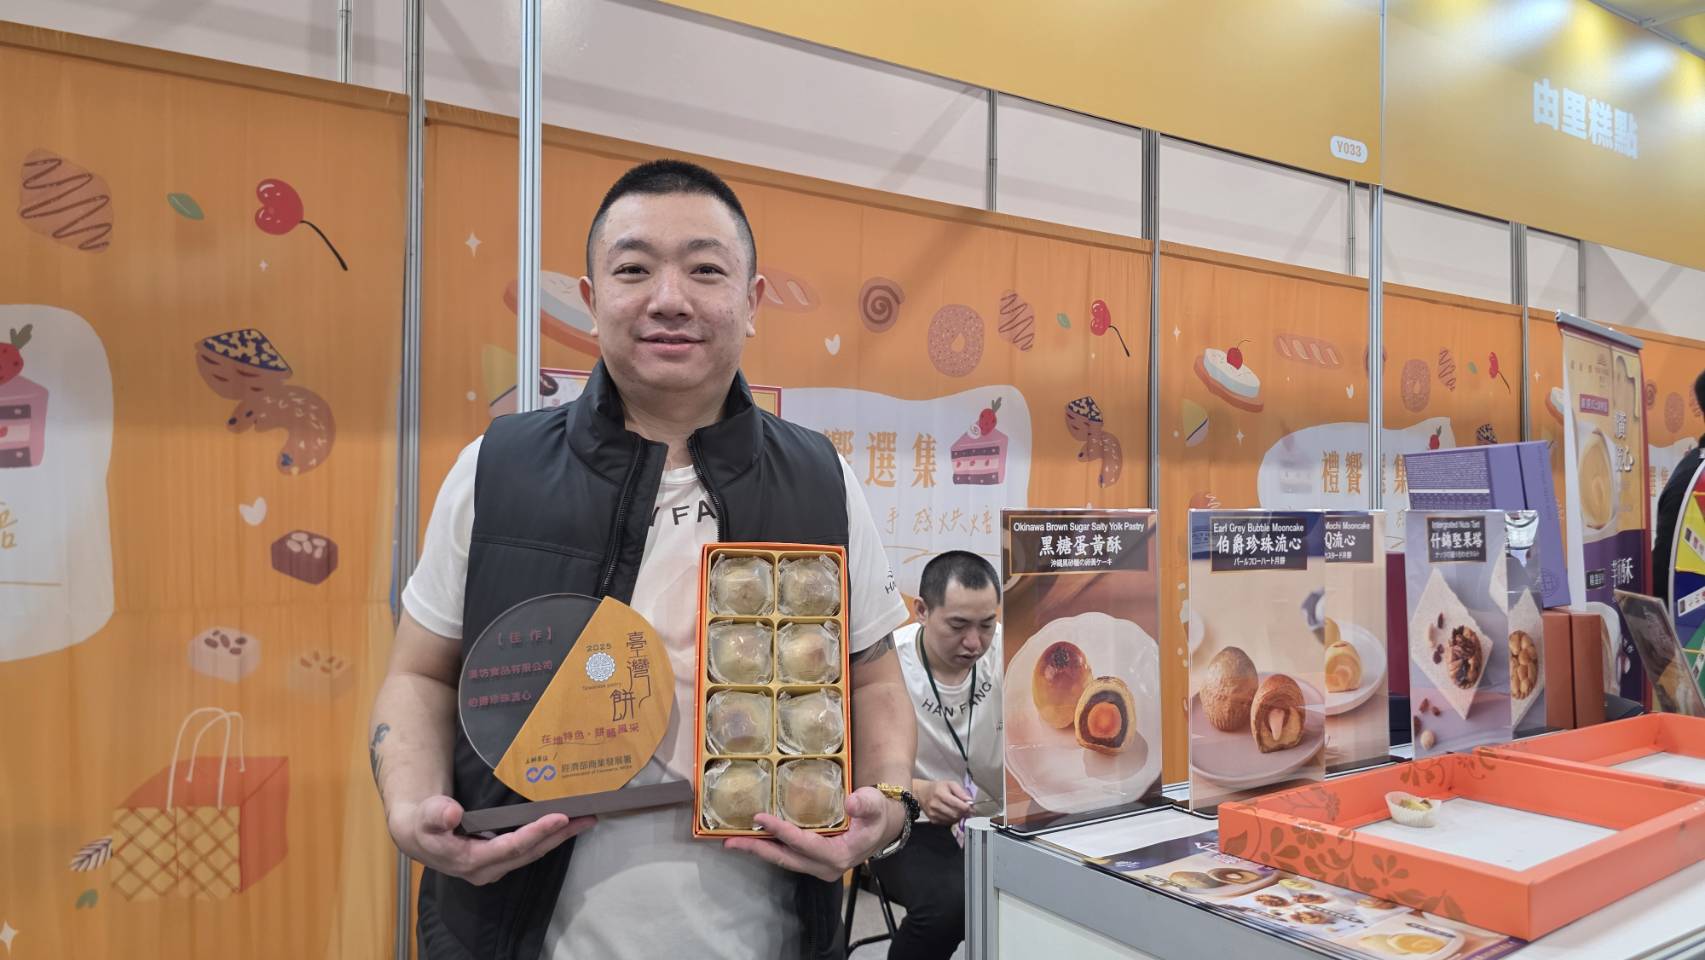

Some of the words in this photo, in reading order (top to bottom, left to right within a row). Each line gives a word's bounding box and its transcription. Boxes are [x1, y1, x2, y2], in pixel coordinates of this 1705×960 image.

[1533, 79, 1638, 159] 由里糕點
[1336, 140, 1362, 157] Y033
[672, 500, 717, 531] FA
[1013, 523, 1045, 531] Okinawa
[1046, 523, 1068, 531] Brown
[1070, 523, 1090, 533] Sugar
[1091, 522, 1108, 532] Salty
[1109, 522, 1122, 531] Yolk
[1124, 523, 1144, 532] Pastry
[1213, 522, 1228, 533] Earl
[1229, 523, 1246, 534] Grey
[1247, 523, 1270, 533] Bubble
[1272, 523, 1304, 532] Mooncake
[1342, 521, 1370, 530] Mooncake
[1039, 535, 1123, 556] 黑糖蛋黃酥
[1216, 533, 1302, 555] 伯爵珍珠流心
[1431, 531, 1483, 549] 什錦堅果塔
[586, 643, 612, 652] 2025
[921, 698, 954, 717] HAN
[960, 681, 992, 715] FANG
